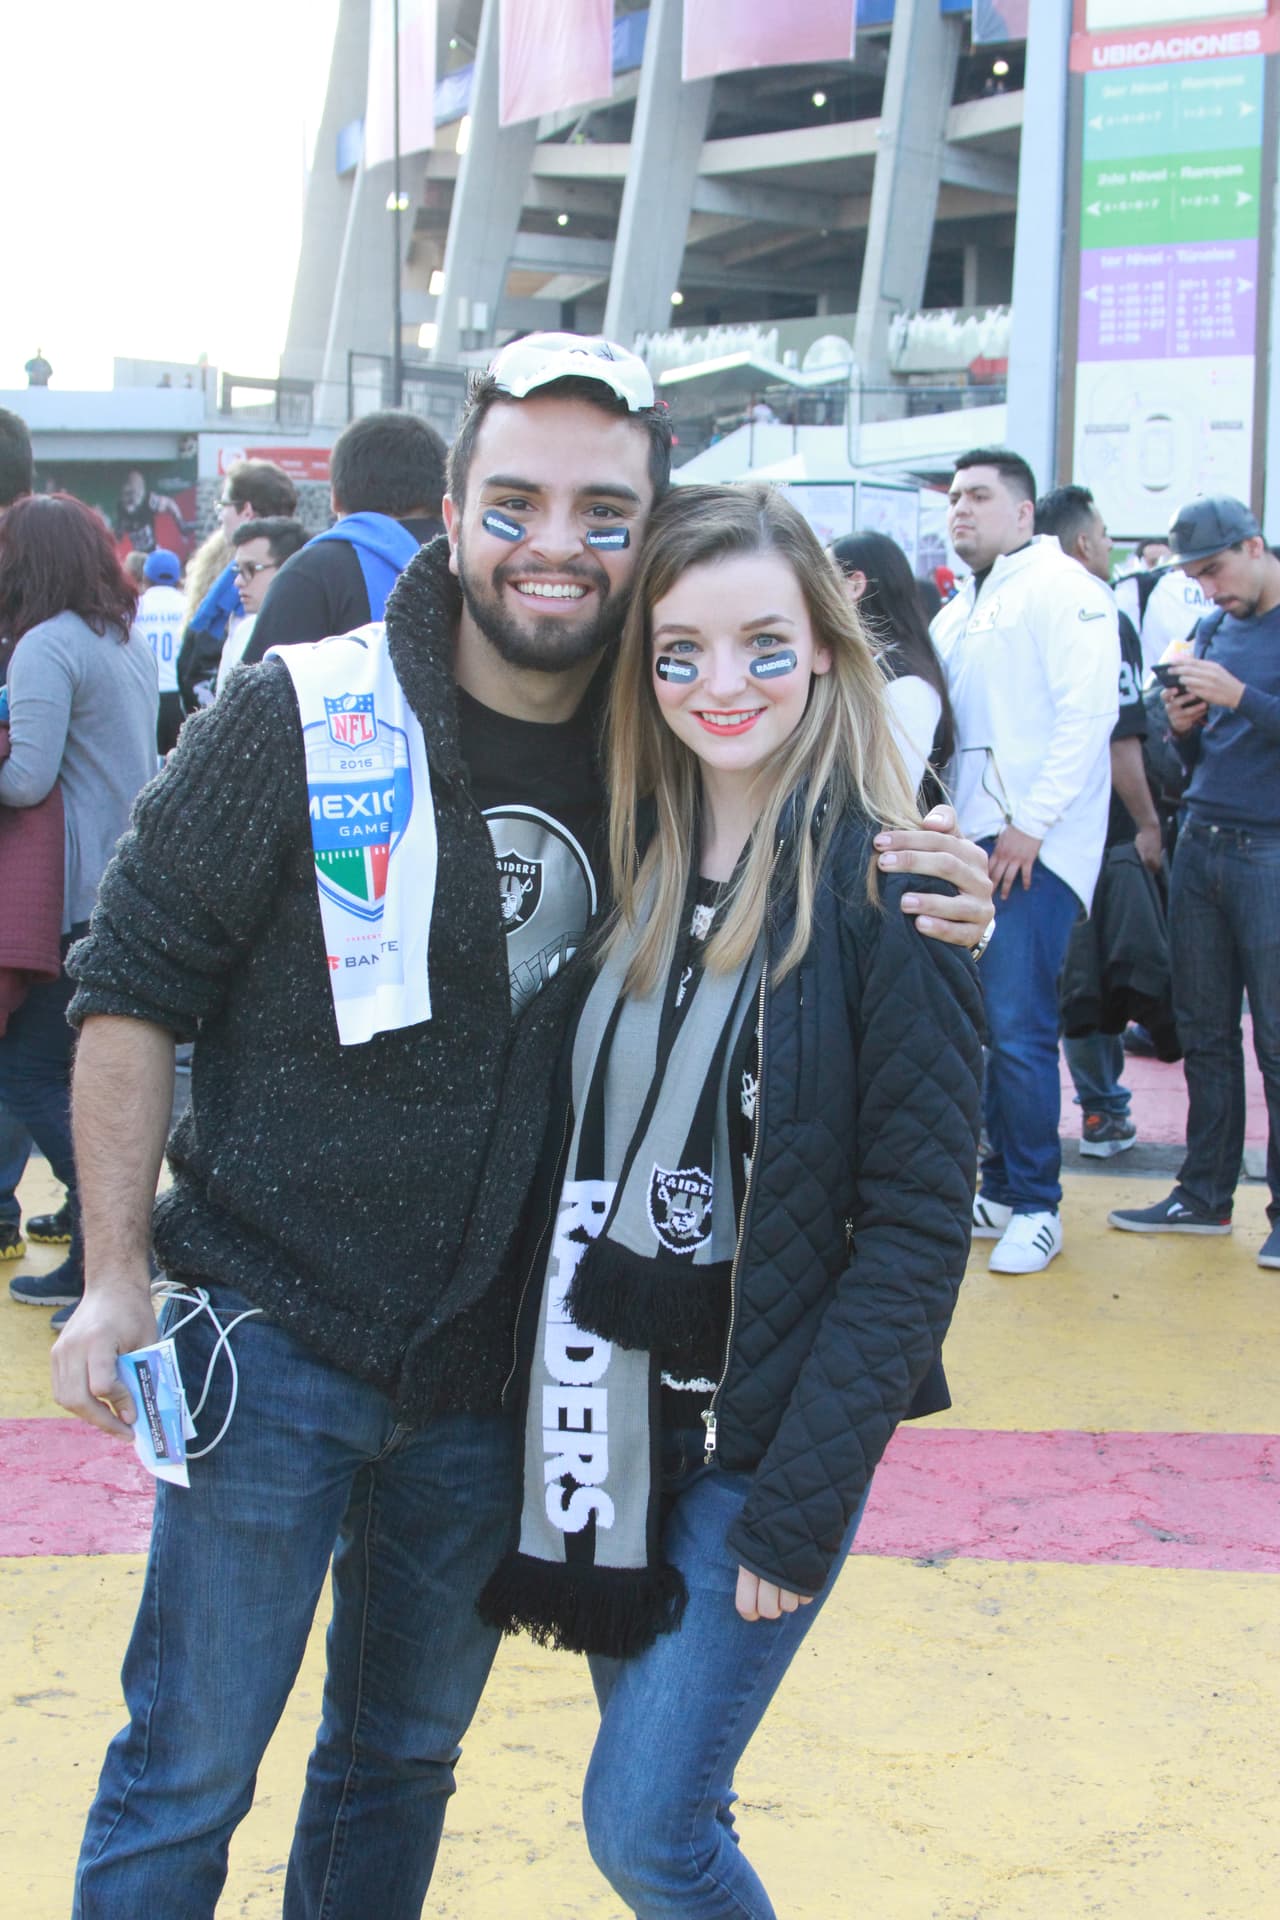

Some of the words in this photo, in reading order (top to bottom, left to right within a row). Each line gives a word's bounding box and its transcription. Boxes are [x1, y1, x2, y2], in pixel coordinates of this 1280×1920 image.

[1092, 30, 1261, 67] UBICACIONES
[487, 516, 519, 537] RAIDERS
[590, 535, 625, 544] RAIDERS
[659, 663, 692, 677] RAIDERS
[756, 658, 792, 674] RAIDERS
[332, 714, 374, 746] NFL
[340, 758, 374, 770] 2016
[340, 822, 390, 837] GAME
[495, 860, 537, 875] AIDERS
